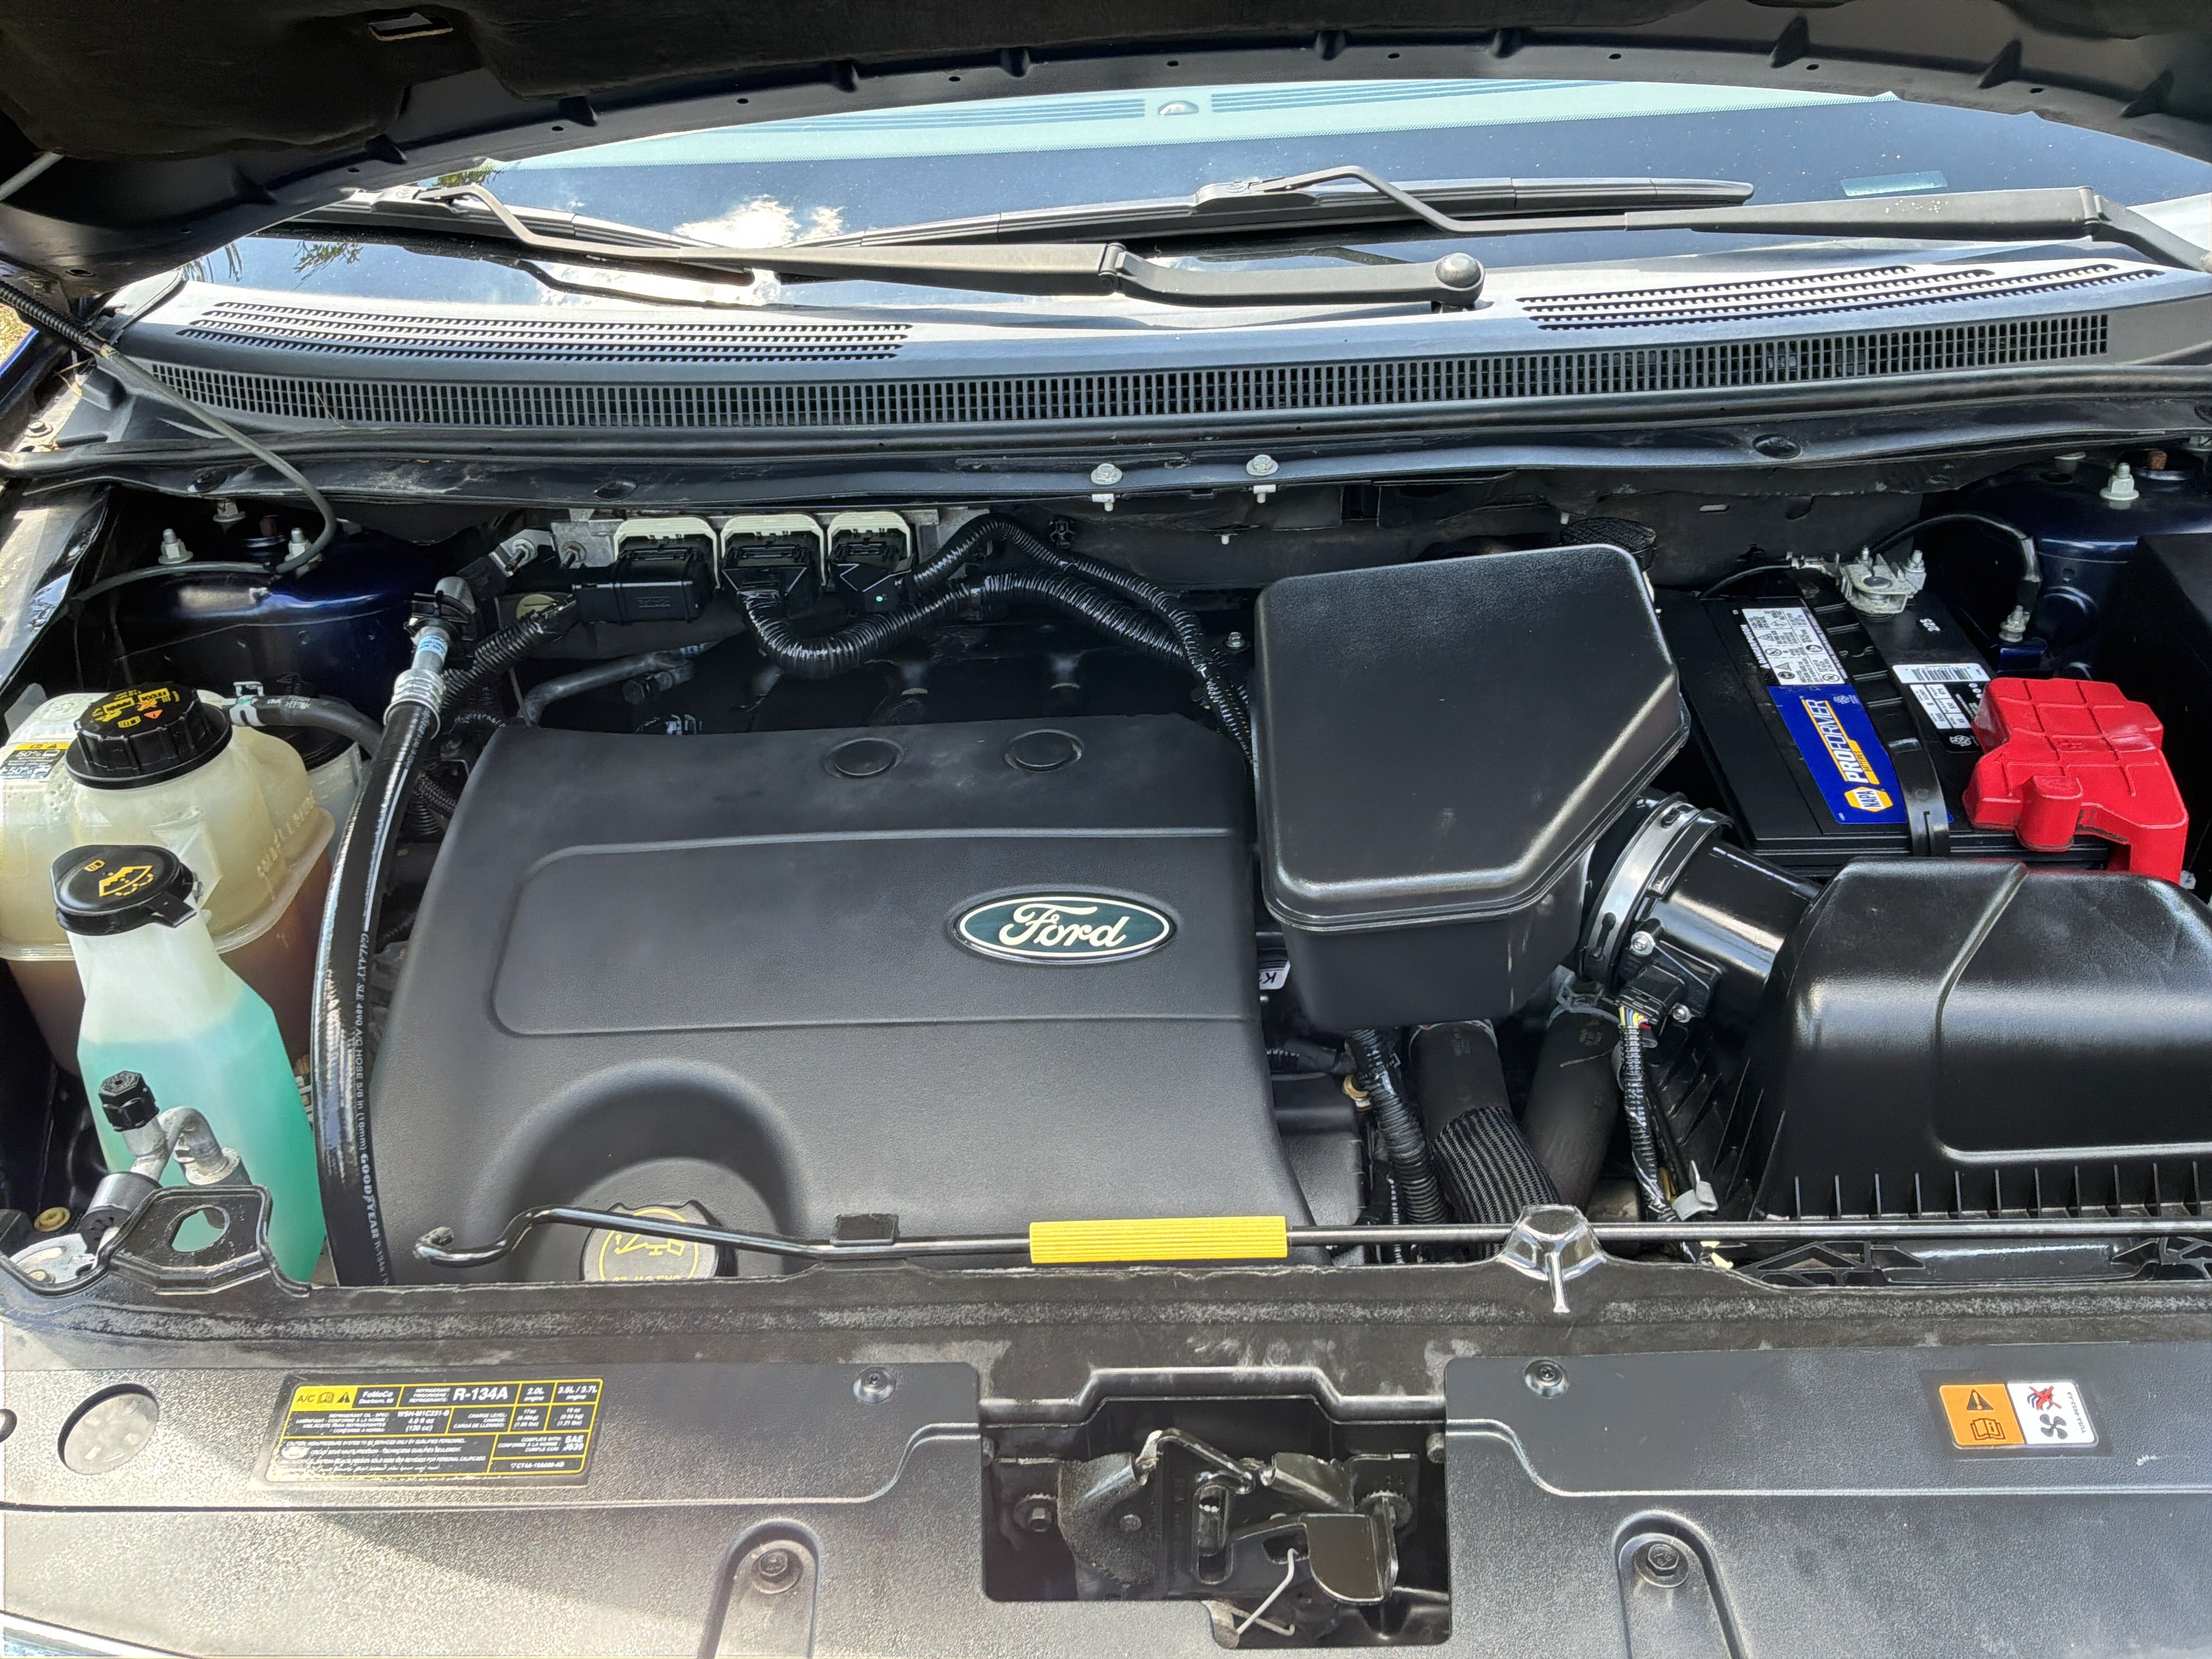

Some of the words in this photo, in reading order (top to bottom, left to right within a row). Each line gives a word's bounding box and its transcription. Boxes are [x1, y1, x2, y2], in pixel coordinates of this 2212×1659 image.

[1805, 699, 1869, 783] PROFORMER
[1854, 751, 1872, 772] BATTERIES
[1857, 791, 1882, 808] NAPA
[998, 903, 1130, 947] Ford
[357, 933, 369, 981] GALAXY
[356, 983, 365, 1001] SLE
[360, 1153, 380, 1239] GOODYEAR
[296, 1394, 315, 1403] A/C
[362, 1390, 394, 1398] FoMoCo
[452, 1386, 509, 1401] R-134A
[526, 1387, 545, 1395] 2.0L
[565, 1435, 585, 1443] SAE
